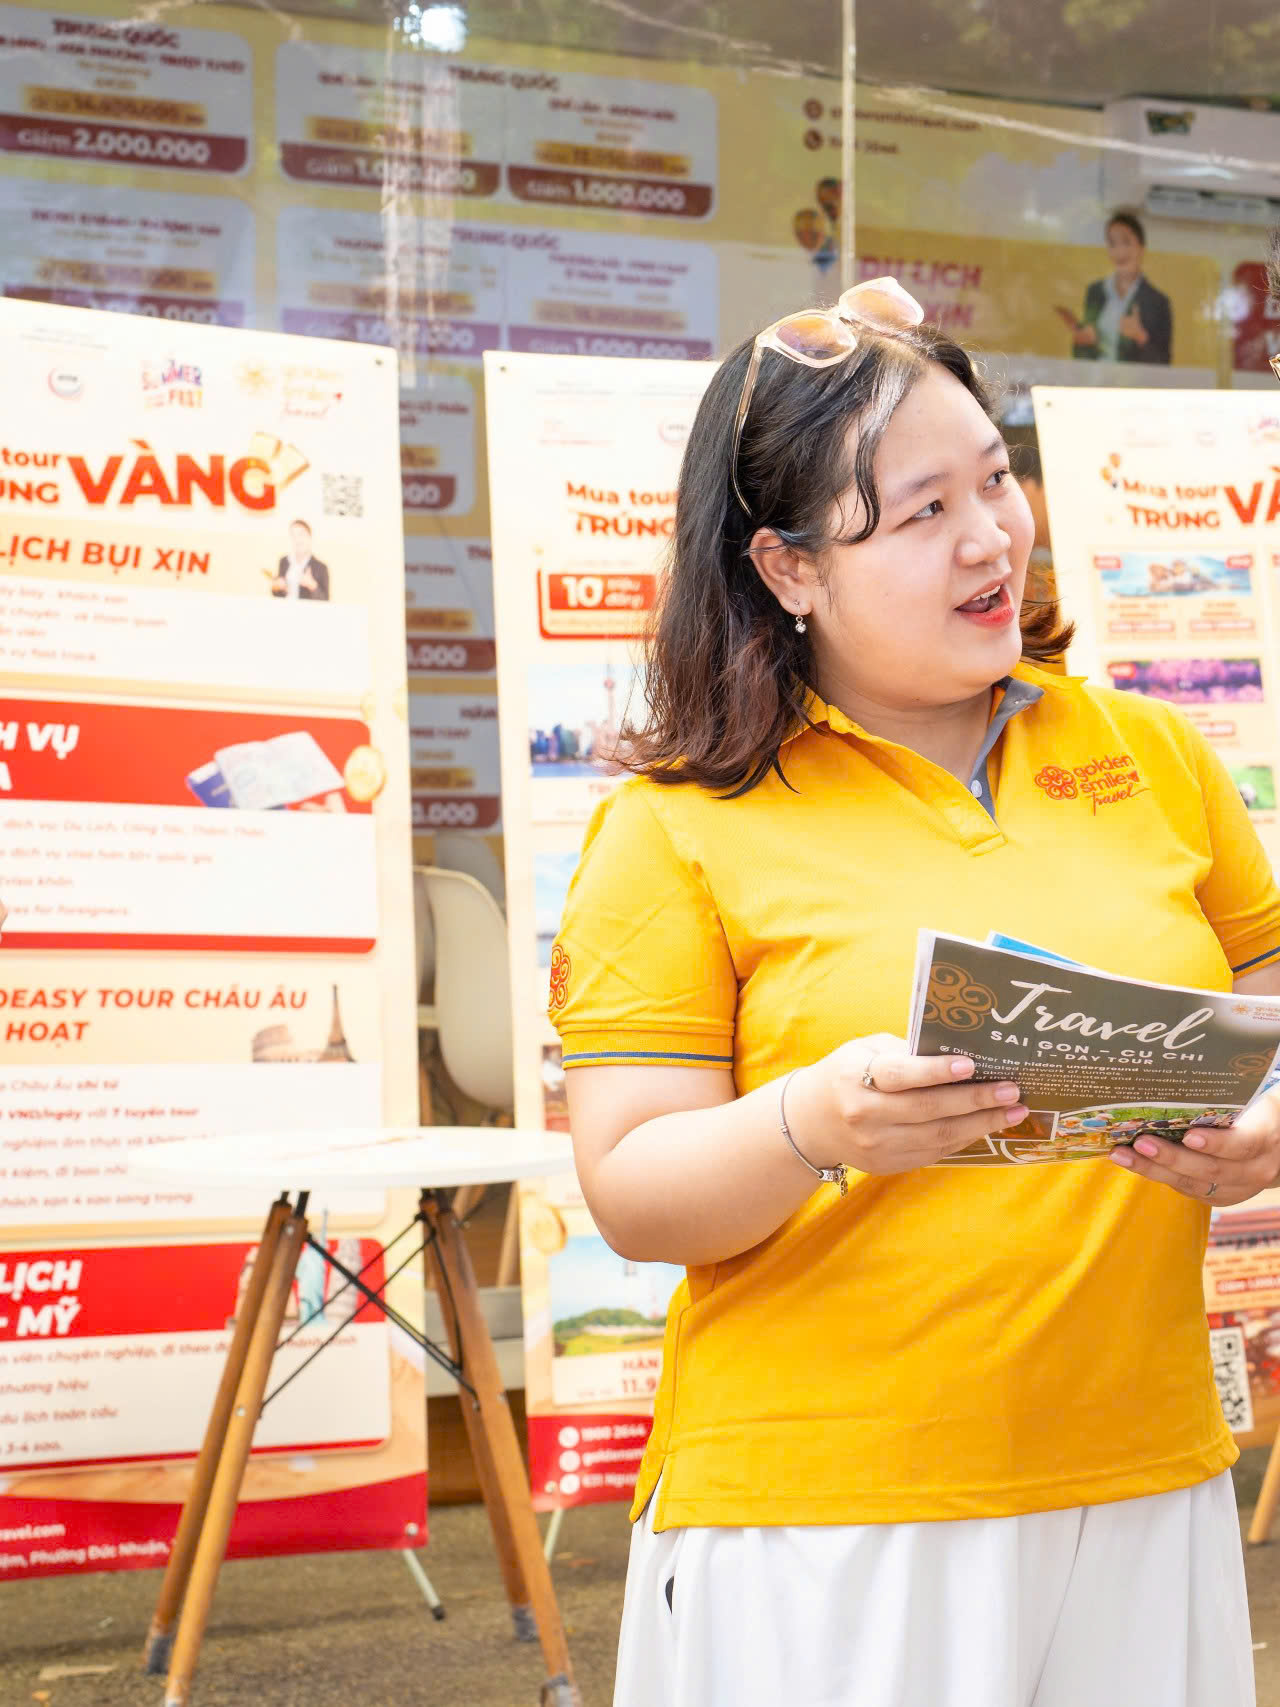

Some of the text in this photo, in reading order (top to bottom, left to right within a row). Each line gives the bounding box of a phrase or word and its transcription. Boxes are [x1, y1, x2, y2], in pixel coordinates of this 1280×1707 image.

[73, 129, 211, 163] 2.000.000
[2, 447, 60, 468] tour
[67, 438, 277, 511] VÀNG
[567, 480, 619, 506] Mua
[1126, 502, 1220, 530] TRÚNG
[0, 535, 211, 581] ỊCH BỤI XỊN
[561, 576, 604, 608] 10
[27, 722, 80, 761] VỤ
[1073, 754, 1136, 783] golden
[1080, 771, 1128, 794] smile
[98, 988, 175, 1009] TOUR
[184, 983, 261, 1009] CHÂU
[269, 983, 309, 1010] ÂU
[990, 979, 1215, 1050] Travel
[6, 1020, 91, 1048] HOẠT
[990, 1030, 1204, 1062] SAI GON CU CHI
[952, 1047, 999, 1064] Discover
[1002, 1058, 1021, 1066] the
[1024, 1059, 1063, 1069] hidden
[1066, 1063, 1139, 1073] underground
[1022, 1066, 1065, 1074] network
[1064, 1054, 1101, 1062] DAY
[1108, 1056, 1154, 1065] TOUR
[16, 1295, 82, 1337] MỸ
